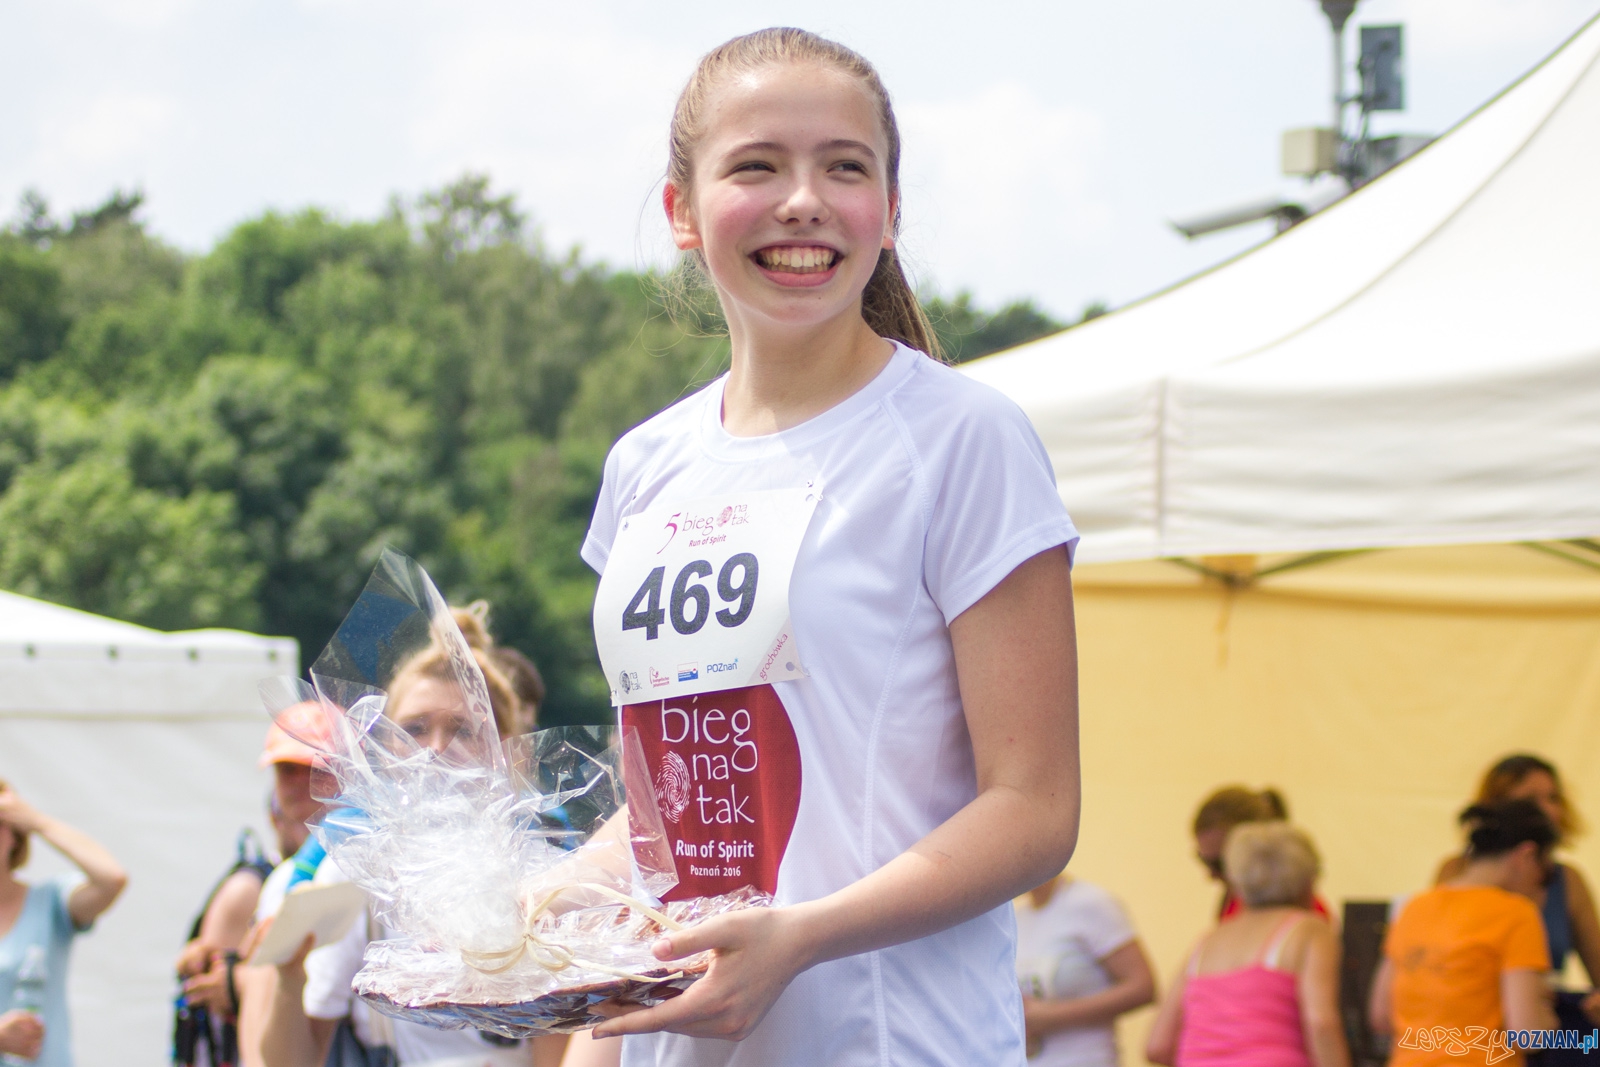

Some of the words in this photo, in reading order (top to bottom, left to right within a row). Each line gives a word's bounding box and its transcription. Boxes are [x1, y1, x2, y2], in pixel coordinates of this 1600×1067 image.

[731, 512, 750, 526] tak
[734, 504, 748, 514] na
[656, 511, 682, 555] 5
[682, 511, 714, 536] bieg
[701, 537, 710, 545] of
[709, 534, 727, 546] Spirit
[622, 552, 759, 641] 469
[661, 696, 758, 773] bieg
[692, 753, 730, 781] na
[696, 783, 755, 825] tak
[675, 839, 698, 858] Run
[700, 839, 715, 859] of
[718, 839, 755, 863] Spirit
[690, 864, 720, 877] Poznań
[723, 865, 741, 877] 2016
